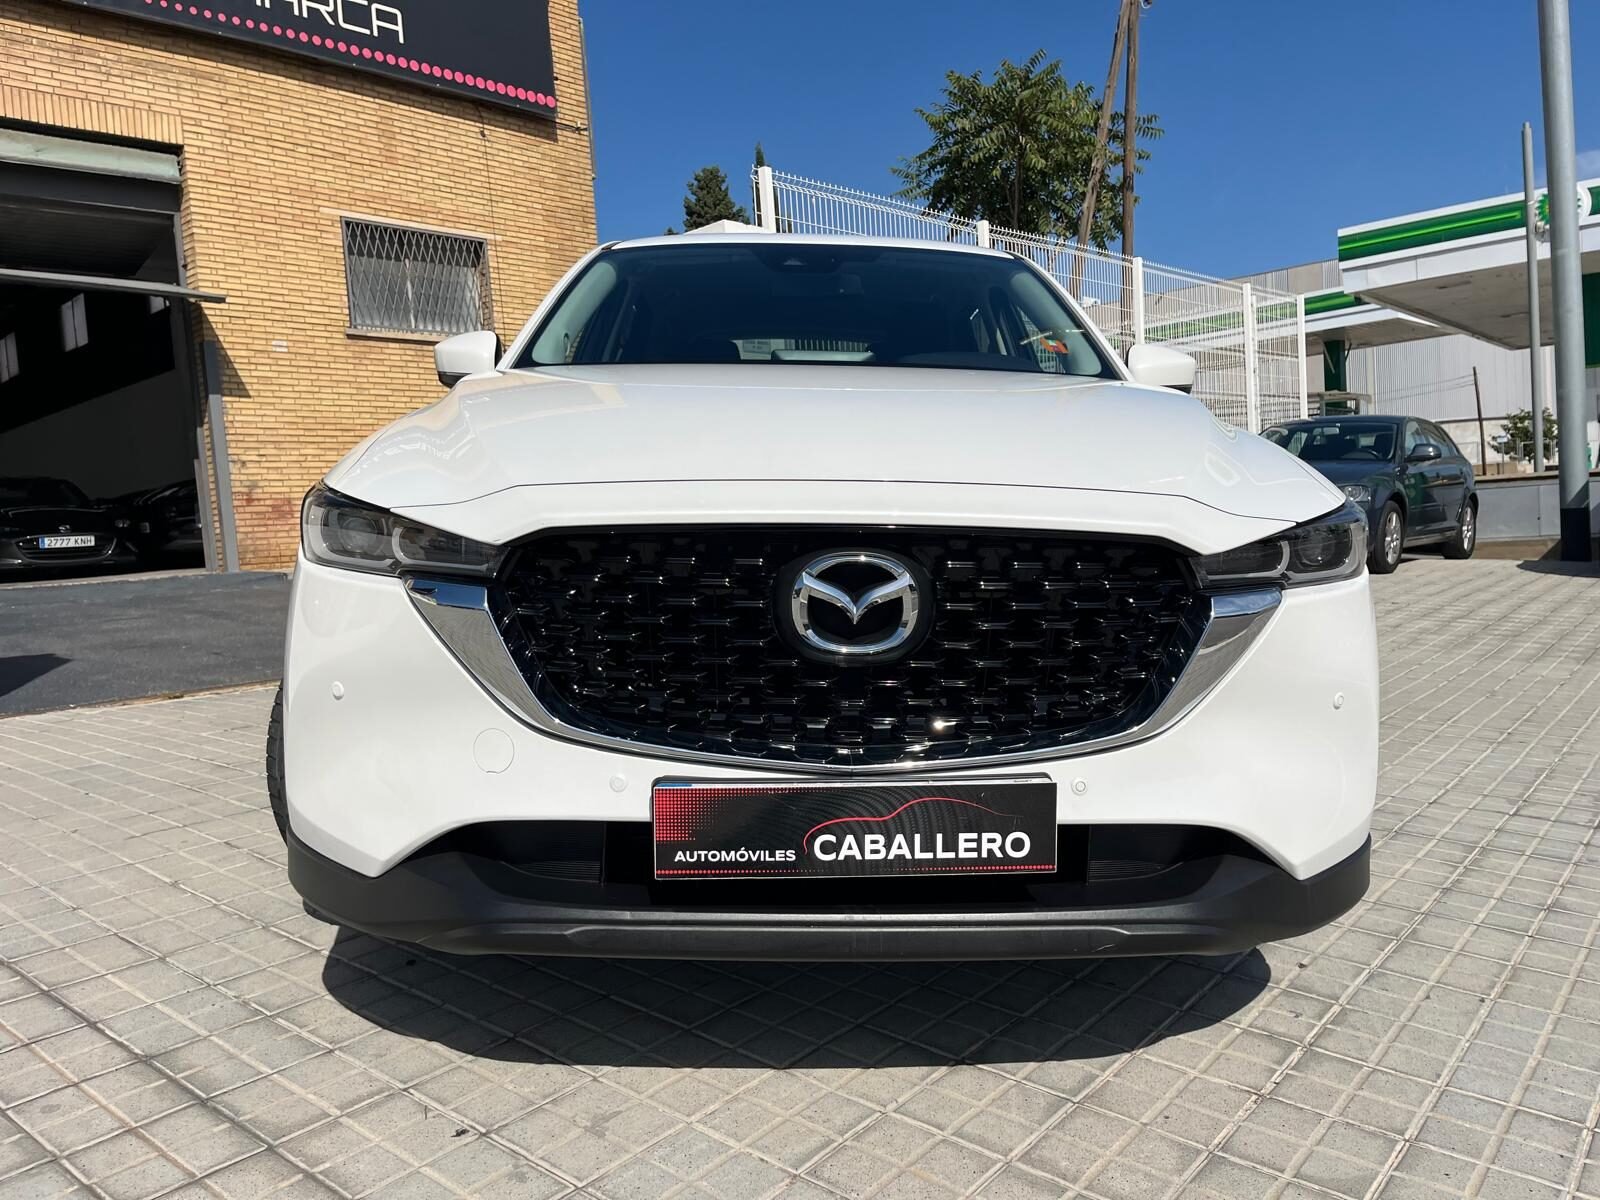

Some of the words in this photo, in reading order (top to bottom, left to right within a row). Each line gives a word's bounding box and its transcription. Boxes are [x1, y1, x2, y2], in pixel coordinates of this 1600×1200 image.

[255, 0, 405, 44] RCA
[47, 538, 71, 547] 2777
[74, 536, 92, 545] KNH
[674, 847, 796, 862] AUTOMÓVILES
[813, 831, 1031, 861] CABALLERO
